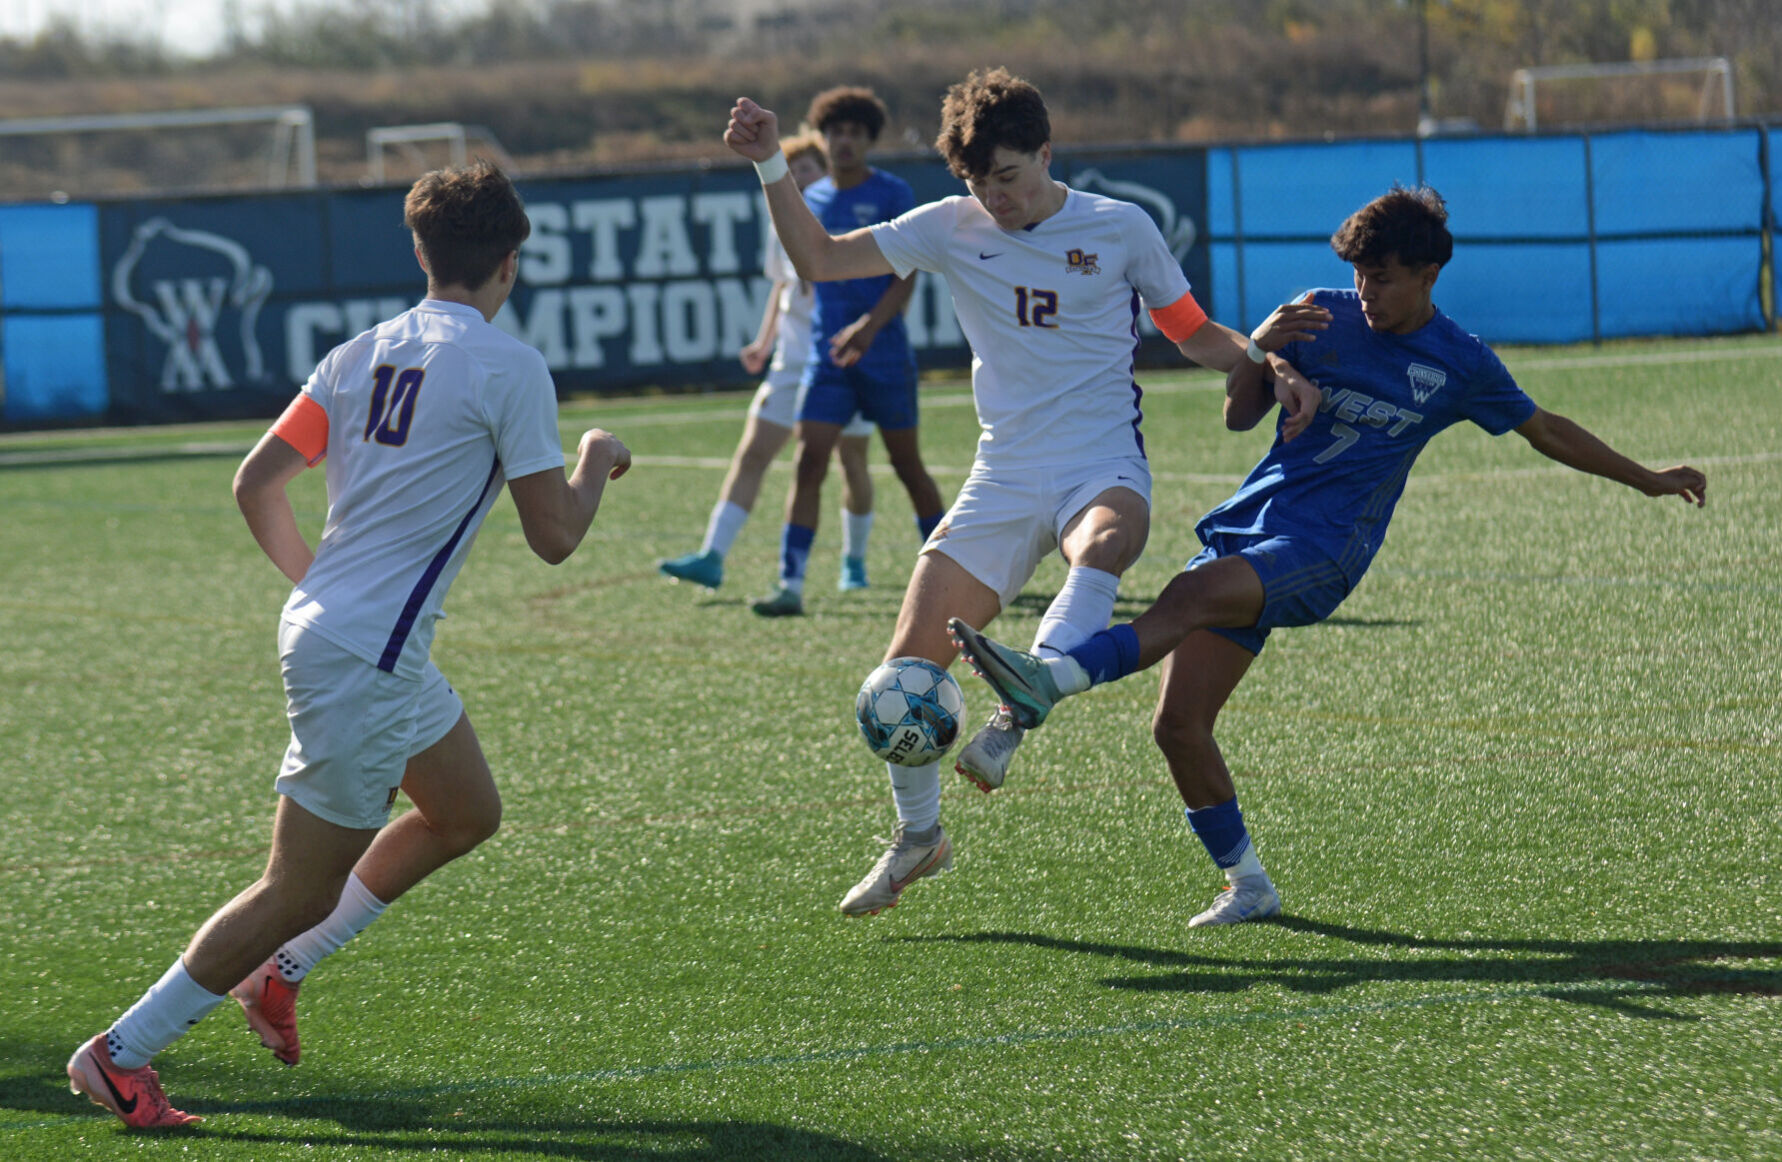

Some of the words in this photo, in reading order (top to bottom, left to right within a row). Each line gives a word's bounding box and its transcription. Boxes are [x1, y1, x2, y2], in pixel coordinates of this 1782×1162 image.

[521, 197, 768, 285] STAT
[1014, 286, 1059, 328] 12
[363, 364, 425, 447] 10
[1312, 422, 1360, 464] 7
